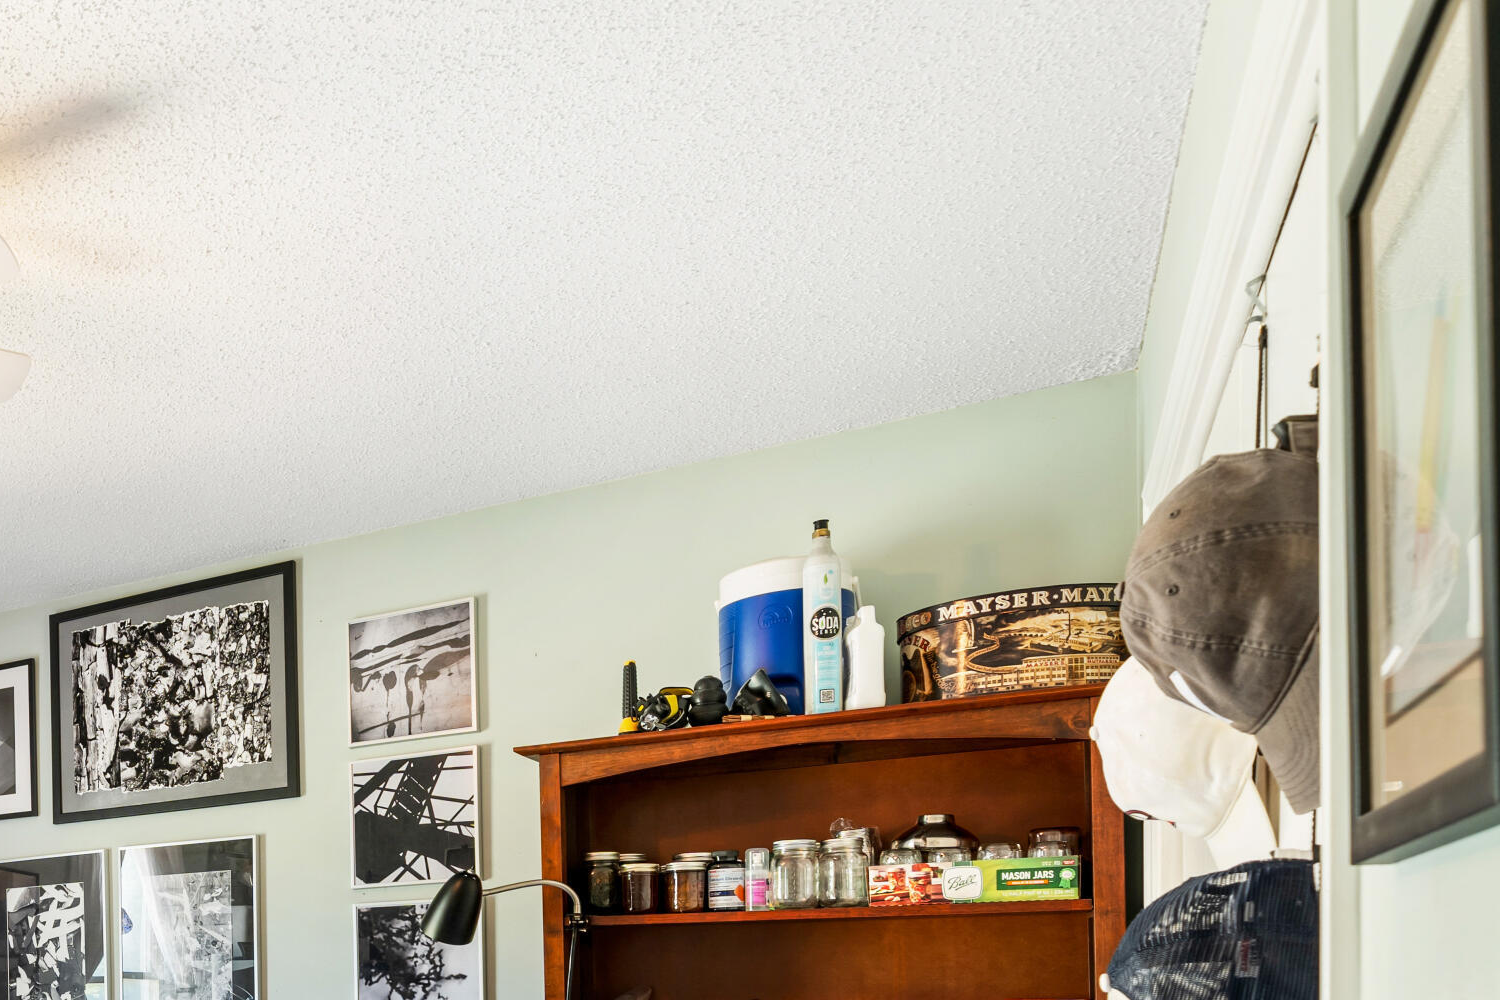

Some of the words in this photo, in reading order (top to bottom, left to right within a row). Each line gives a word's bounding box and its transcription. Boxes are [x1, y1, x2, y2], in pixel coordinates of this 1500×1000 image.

[937, 591, 1050, 622] MAYSER
[812, 615, 839, 631] SODA
[1001, 871, 1031, 881] MASON
[1032, 870, 1054, 880] JARS
